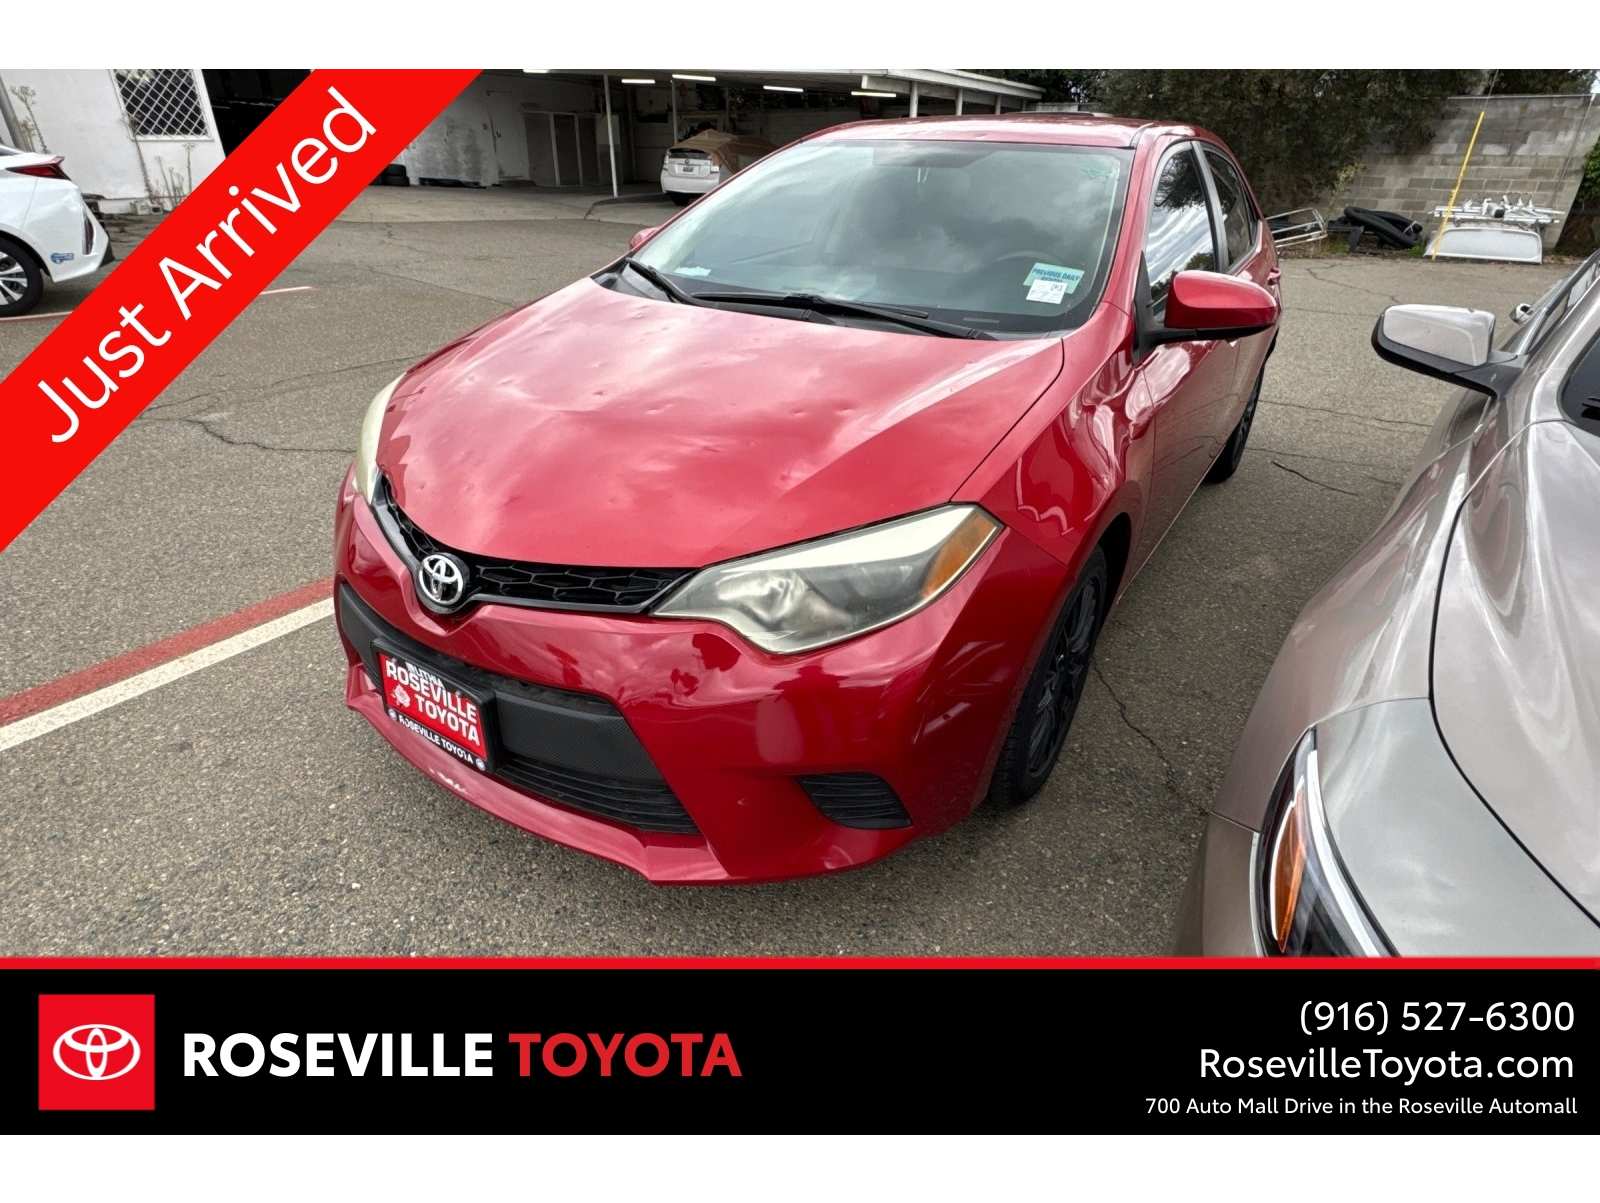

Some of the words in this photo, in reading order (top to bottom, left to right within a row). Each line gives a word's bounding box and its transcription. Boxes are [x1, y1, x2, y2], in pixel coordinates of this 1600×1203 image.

[385, 660, 477, 723] ROSEVILLE
[399, 715, 441, 745] ROSEVILLE
[441, 738, 474, 765] TOYOTA
[415, 694, 480, 746] TOYOTA
